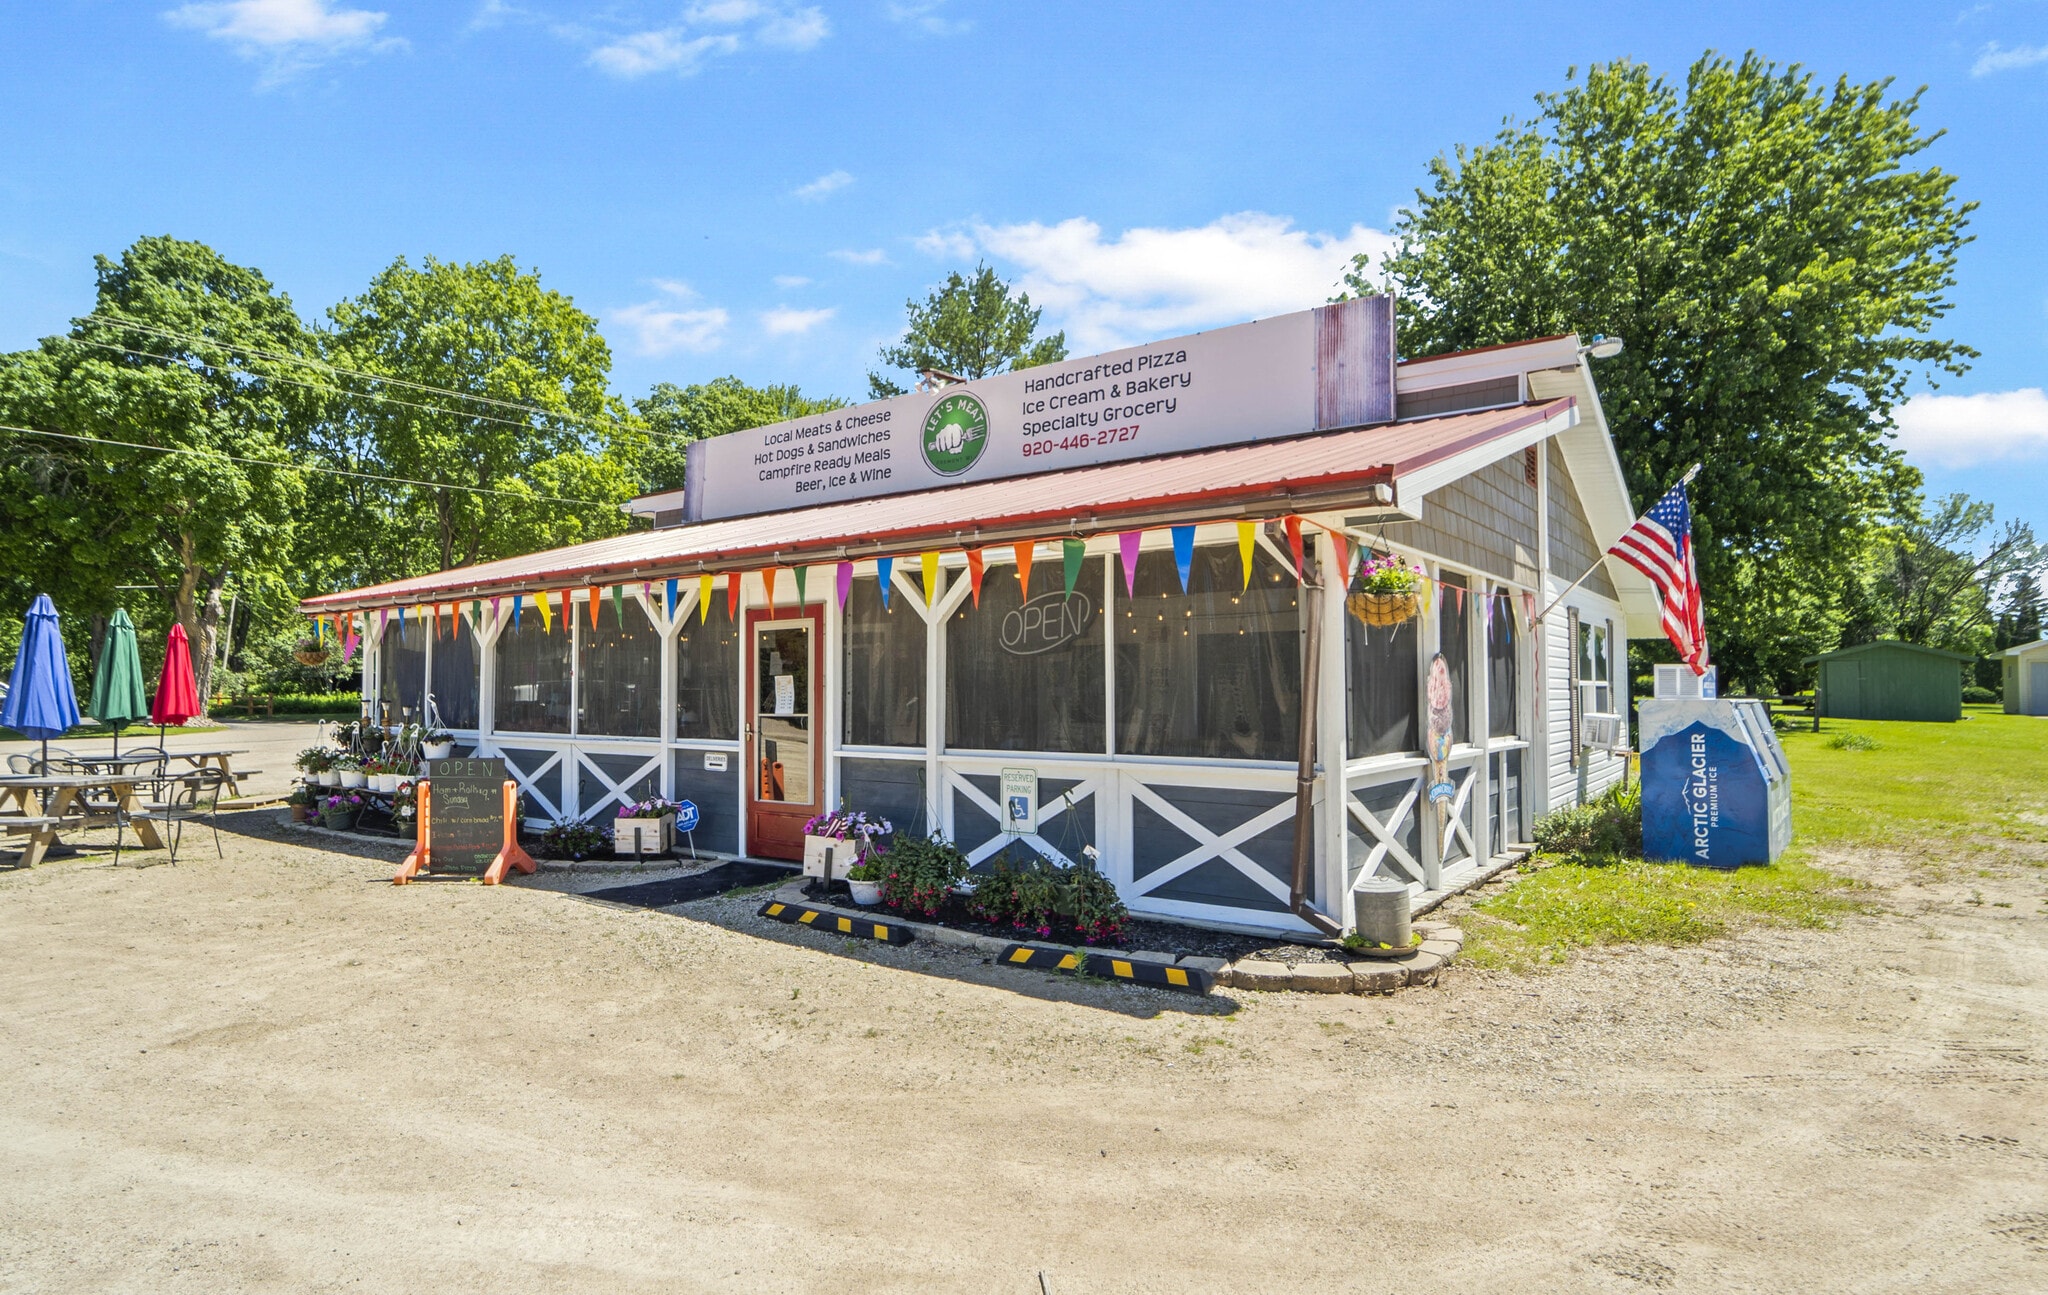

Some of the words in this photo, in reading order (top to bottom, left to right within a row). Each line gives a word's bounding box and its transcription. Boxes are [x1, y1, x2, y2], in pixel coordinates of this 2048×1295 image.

[1025, 358, 1133, 393] Handcrafted
[1138, 350, 1186, 370] Pizza
[1022, 400, 1045, 415] Ice
[1050, 388, 1105, 410] Cream
[1110, 385, 1120, 398] &
[1126, 371, 1192, 395] Bakery
[764, 429, 792, 446] Local
[795, 423, 832, 440] Meats
[835, 420, 843, 432] &
[846, 410, 891, 430] Cheese
[927, 401, 953, 431] LET'S
[957, 399, 984, 423] MEAT
[1022, 412, 1098, 437] Specialty
[1104, 397, 1177, 422] Grocery
[754, 450, 774, 466] Hot
[776, 445, 804, 462] Dogs
[807, 444, 815, 455] &
[818, 429, 891, 453] Sandwiches
[1022, 425, 1140, 457] 920-446-2727
[759, 462, 811, 482] Campfire
[814, 454, 851, 472] Ready
[854, 448, 891, 465] Meals
[795, 477, 826, 493] Beer,
[828, 475, 846, 487] Ice
[849, 472, 857, 484] &
[860, 466, 892, 482] Wine
[1002, 599, 1082, 646] OPEN
[440, 761, 493, 777] OPEN
[1003, 773, 1034, 783] RESERVED
[1691, 733, 1707, 798] GLACIER
[1709, 766, 1717, 782] ICE
[432, 784, 451, 794] Ham
[443, 794, 469, 807] Sunday
[1006, 785, 1031, 794] PARKING
[676, 807, 695, 823] ADT
[1710, 784, 1718, 828] PREMIUM
[1693, 803, 1709, 860] ARCTIC
